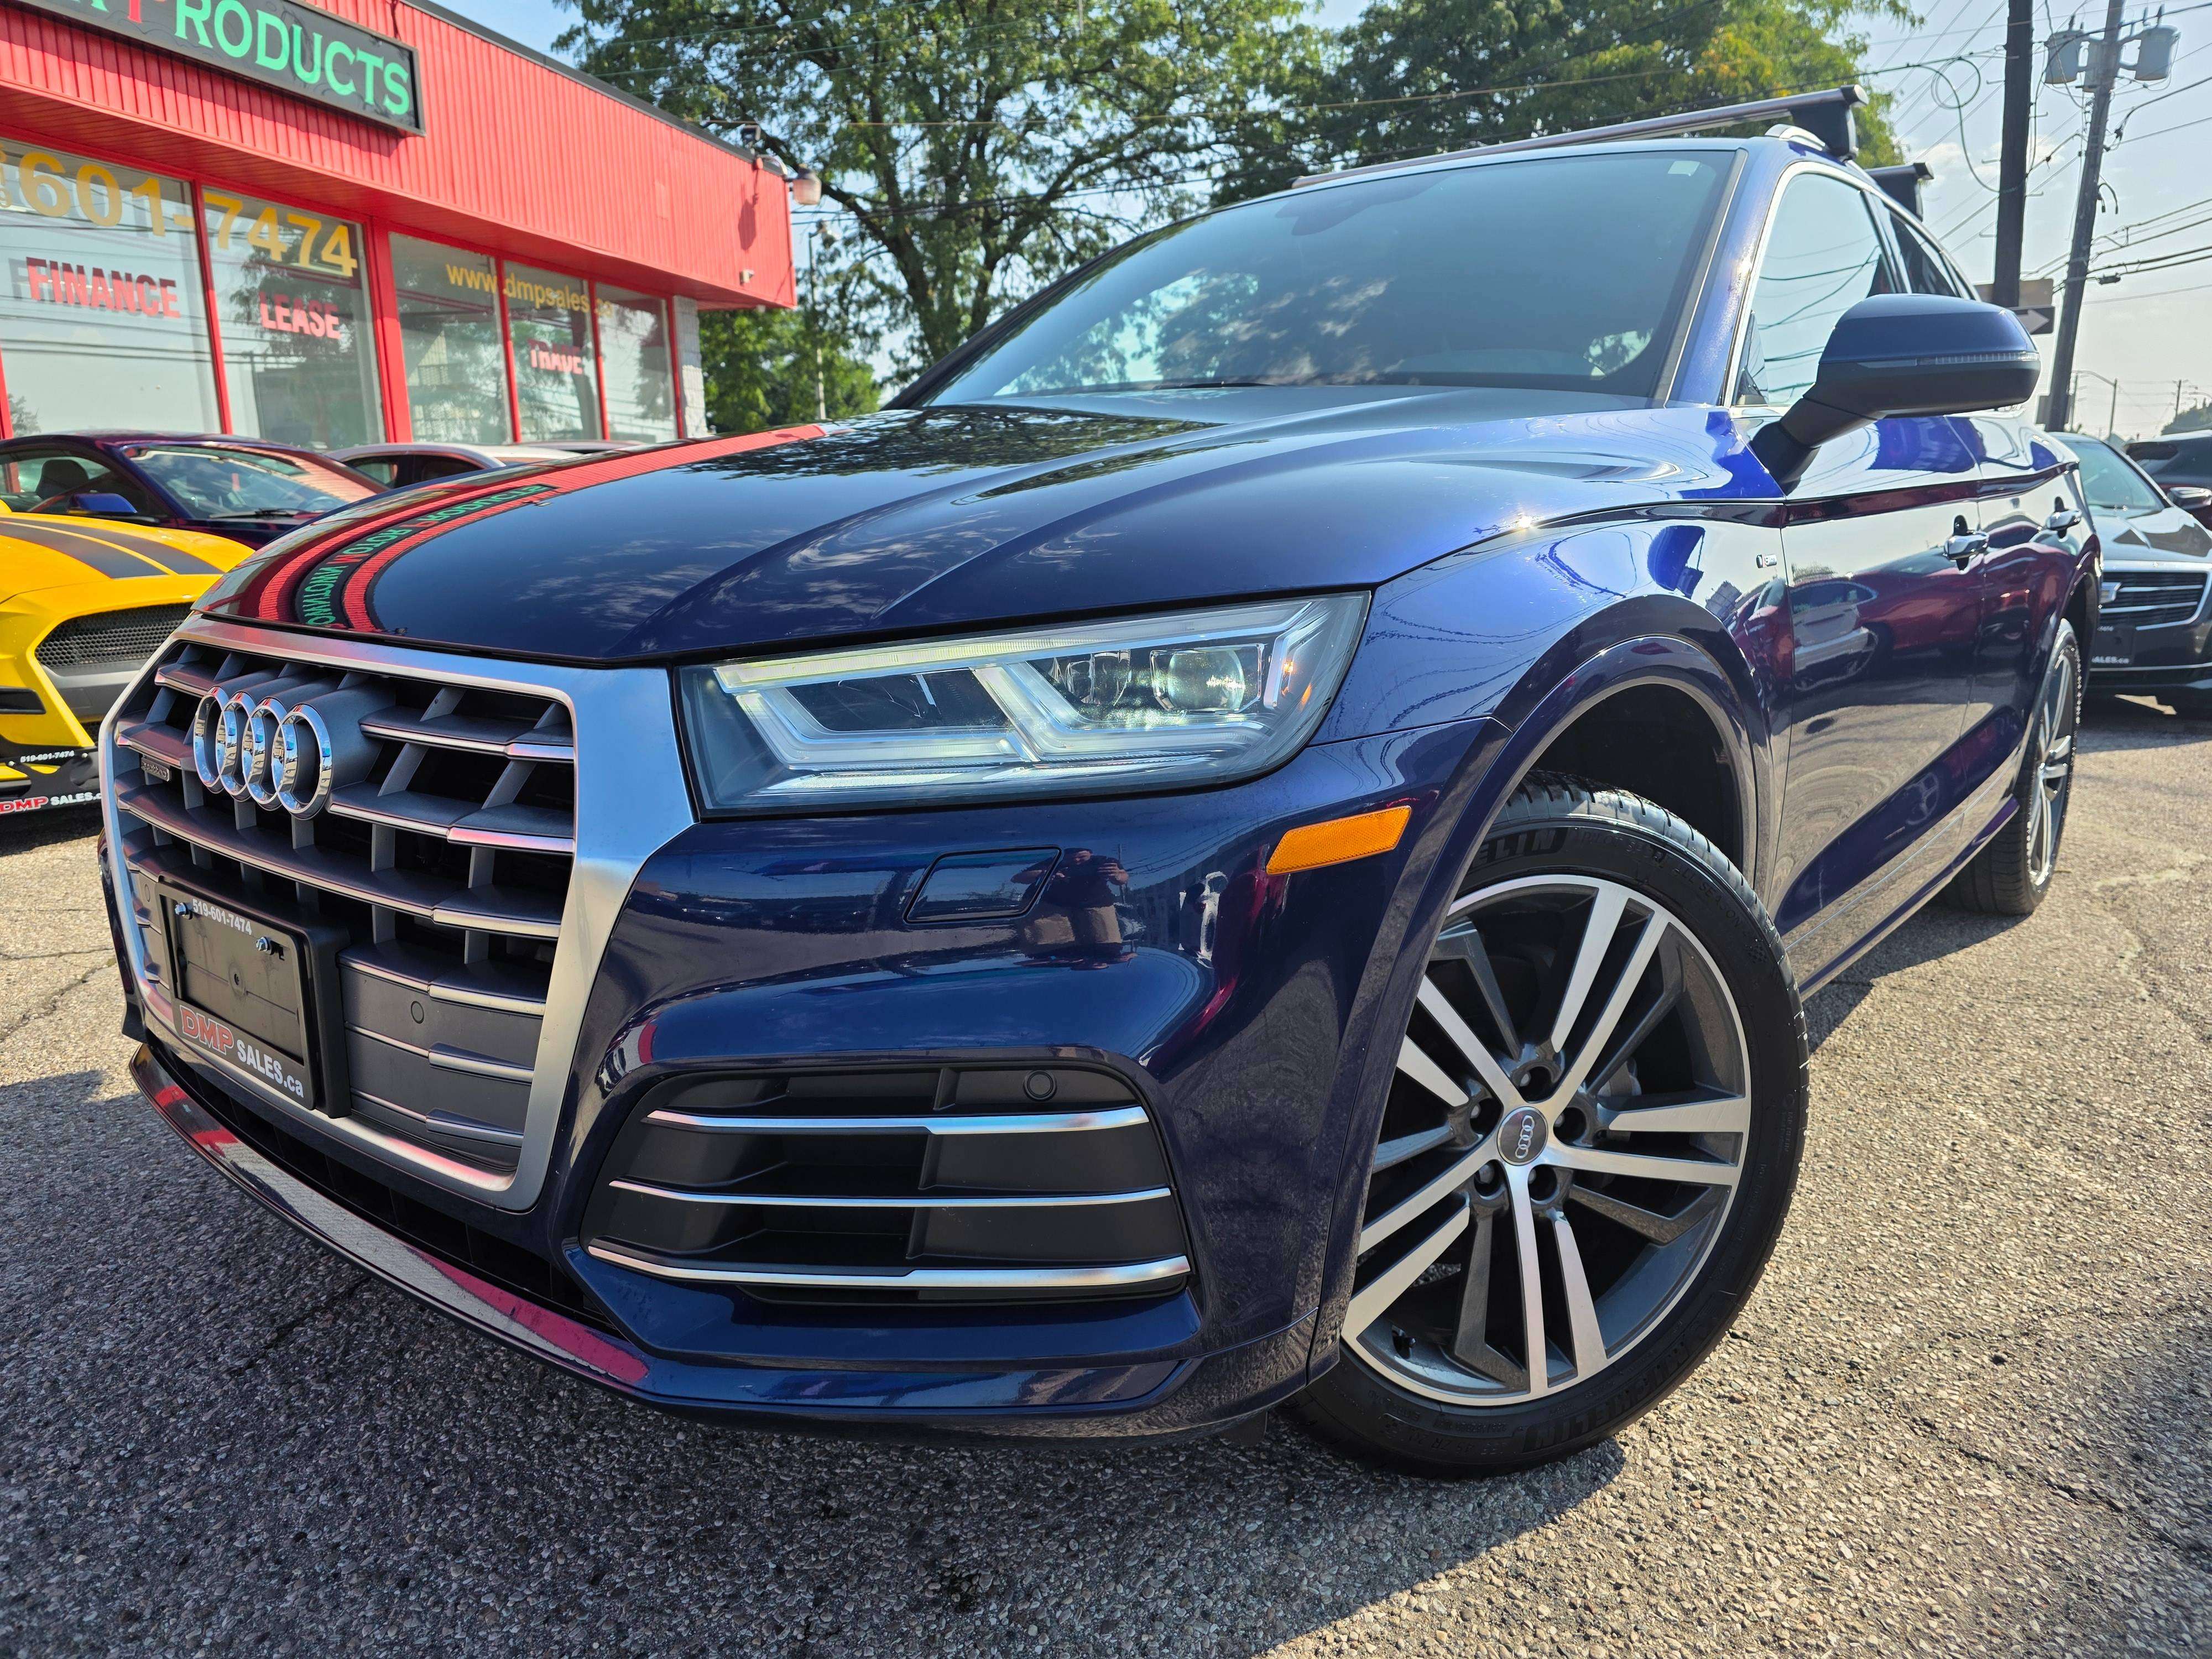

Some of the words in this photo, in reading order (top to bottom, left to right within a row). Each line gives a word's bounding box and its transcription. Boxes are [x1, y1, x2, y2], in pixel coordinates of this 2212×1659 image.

[26, 257, 181, 319] FINANCE
[259, 294, 341, 340] LEASE
[20, 750, 75, 763] 519-601-7474
[0, 796, 49, 815] DMP
[50, 792, 101, 806] SALES.c
[192, 898, 252, 936] 519-601-7474
[179, 1004, 234, 1055] DMP
[236, 1039, 304, 1098] SALES.ca
